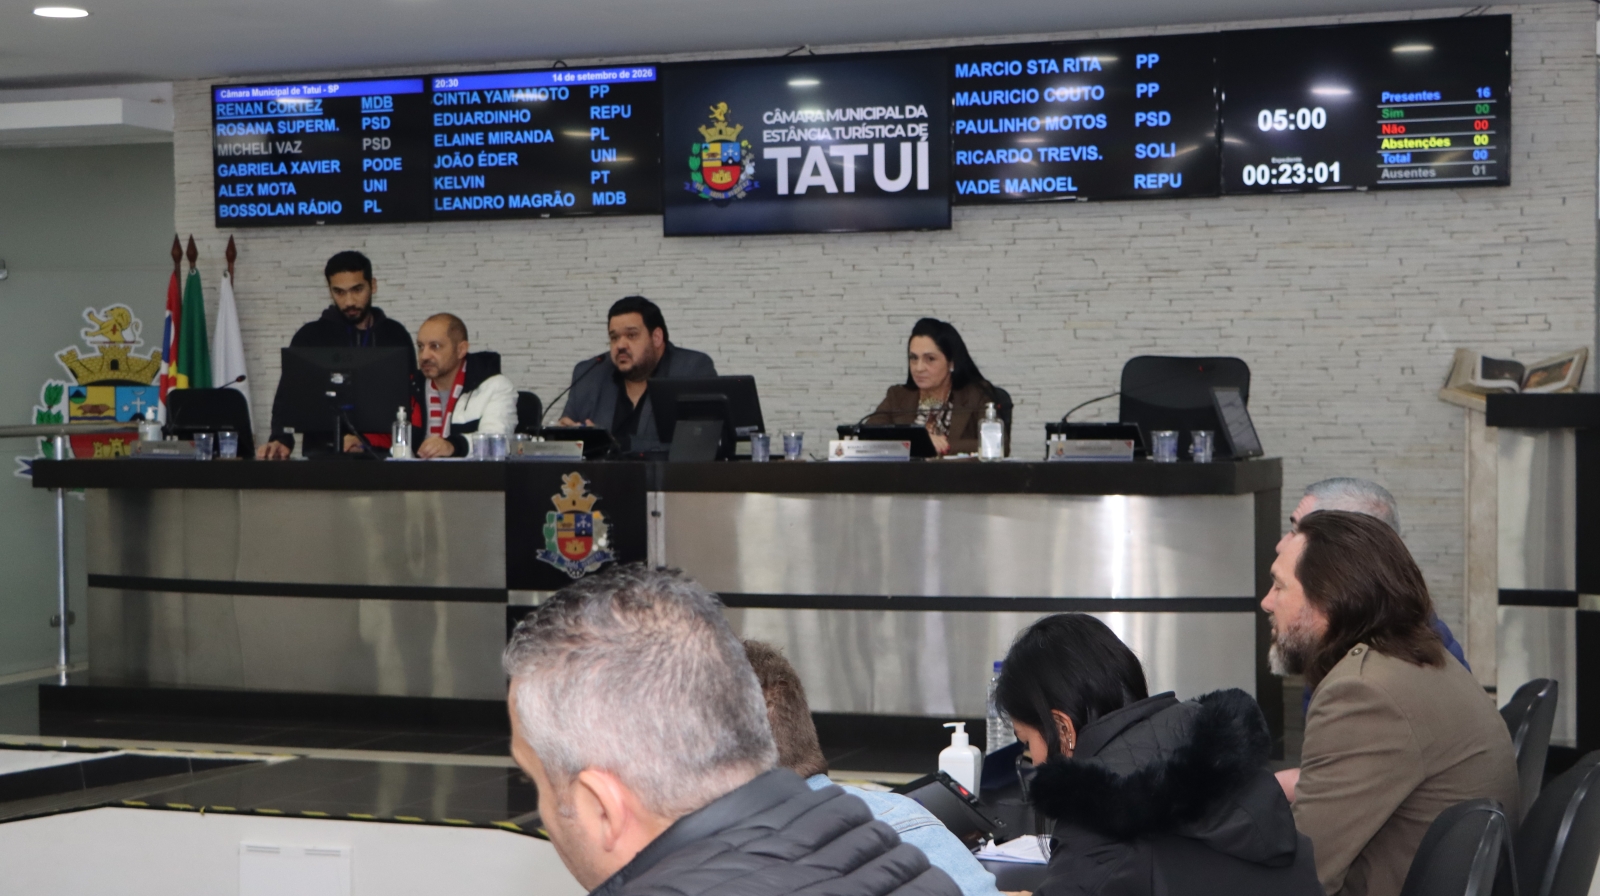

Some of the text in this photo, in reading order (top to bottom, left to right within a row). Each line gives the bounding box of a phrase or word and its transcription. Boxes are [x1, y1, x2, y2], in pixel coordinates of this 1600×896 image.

[956, 57, 1101, 77] MARCIO STA RITA
[1136, 54, 1159, 69] PP
[553, 69, 652, 82] 14 de setembro de 2026
[435, 79, 458, 88] 20:30
[1137, 83, 1159, 98] PP
[221, 89, 250, 98] Câmara
[252, 87, 289, 97] Municipal
[291, 87, 301, 95] de
[328, 85, 339, 93] SP
[433, 87, 569, 106] CINTIA YAMAMOTO
[590, 85, 610, 98] PP
[956, 86, 1104, 106] MAURICIO COUTO
[1382, 90, 1441, 103] Presentes
[1476, 87, 1491, 98] 16
[217, 99, 322, 115] RENAN CORTEZ
[361, 96, 393, 109] MDB
[1475, 104, 1490, 114] 00
[434, 109, 531, 126] EDUARDINHO
[590, 105, 631, 119] REPU
[763, 105, 928, 125] CÂMARA MUNICIPAL DA
[1257, 107, 1327, 131] 05:00
[1382, 106, 1404, 118] Sim
[362, 117, 390, 130] PSD
[956, 114, 1107, 134] PAULINHO MOTOS
[1135, 112, 1171, 127] PSD
[1474, 120, 1489, 130] 00
[217, 119, 339, 136] ROSANA SUPERM.
[591, 127, 609, 140] PL
[763, 123, 928, 142] ESTÂNCIA TURÍSTICA DE
[1382, 123, 1405, 134] Não
[363, 138, 391, 150] PSD
[434, 129, 554, 147] ELAINE MIRANDA
[1382, 136, 1451, 149] Abstenções
[1474, 134, 1488, 146] 00
[218, 141, 302, 156] MICHELI VAZ
[591, 148, 617, 162] UNI
[956, 145, 1103, 165] RICARDO TREVIS.
[1135, 143, 1176, 159] SOLI
[1473, 150, 1488, 161] 00
[363, 158, 402, 171] PODE
[434, 151, 518, 168] JOÃO ÉDER
[1382, 152, 1411, 164] Total
[218, 160, 340, 177] GABRIELA XAVIER
[763, 136, 929, 195] TATUÍ
[1382, 166, 1436, 179] Ausentes
[1472, 165, 1486, 175] 01
[591, 170, 610, 184] PT
[1243, 161, 1341, 186] 00:23:01
[364, 179, 387, 192] UNI
[434, 175, 485, 189] KELVIN
[956, 177, 1077, 194] VADE MANOEL
[1134, 173, 1182, 189] REPU
[219, 182, 296, 197] ALEX MOTA
[435, 191, 575, 210] LEANDRO MAGRÃO
[592, 192, 626, 205] MDB
[220, 199, 342, 218] BOSSOLAN RÁDIO
[364, 200, 382, 213] PL
